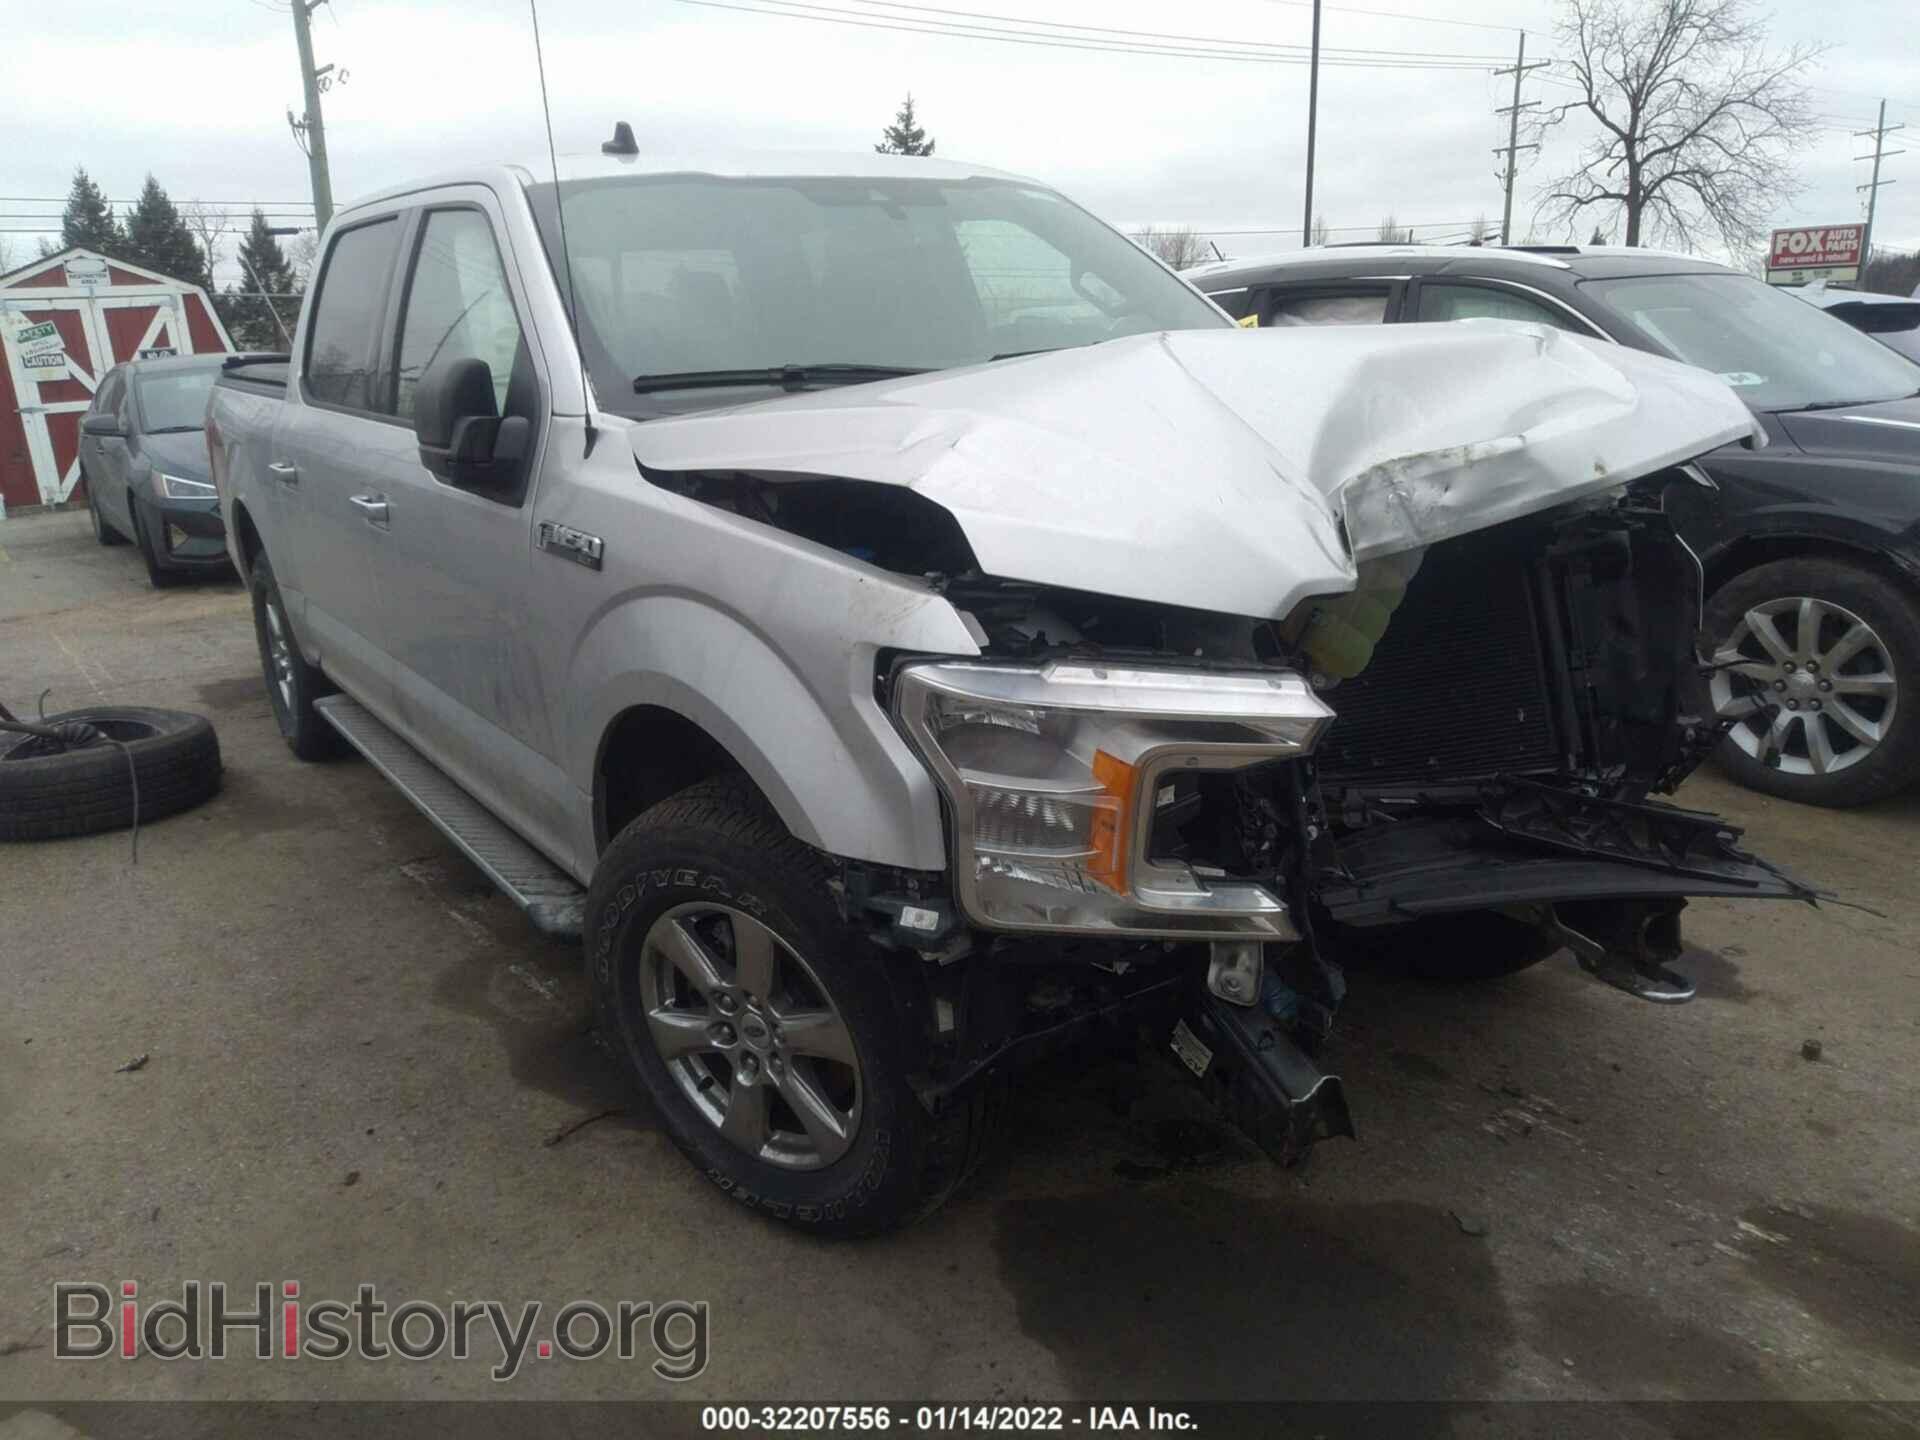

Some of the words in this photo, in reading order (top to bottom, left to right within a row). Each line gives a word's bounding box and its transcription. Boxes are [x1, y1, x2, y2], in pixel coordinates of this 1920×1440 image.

[1827, 229, 1857, 240] AUTO
[1775, 231, 1824, 255] FOX
[1825, 240, 1858, 253] PARTS
[24, 354, 64, 367] CAUTION
